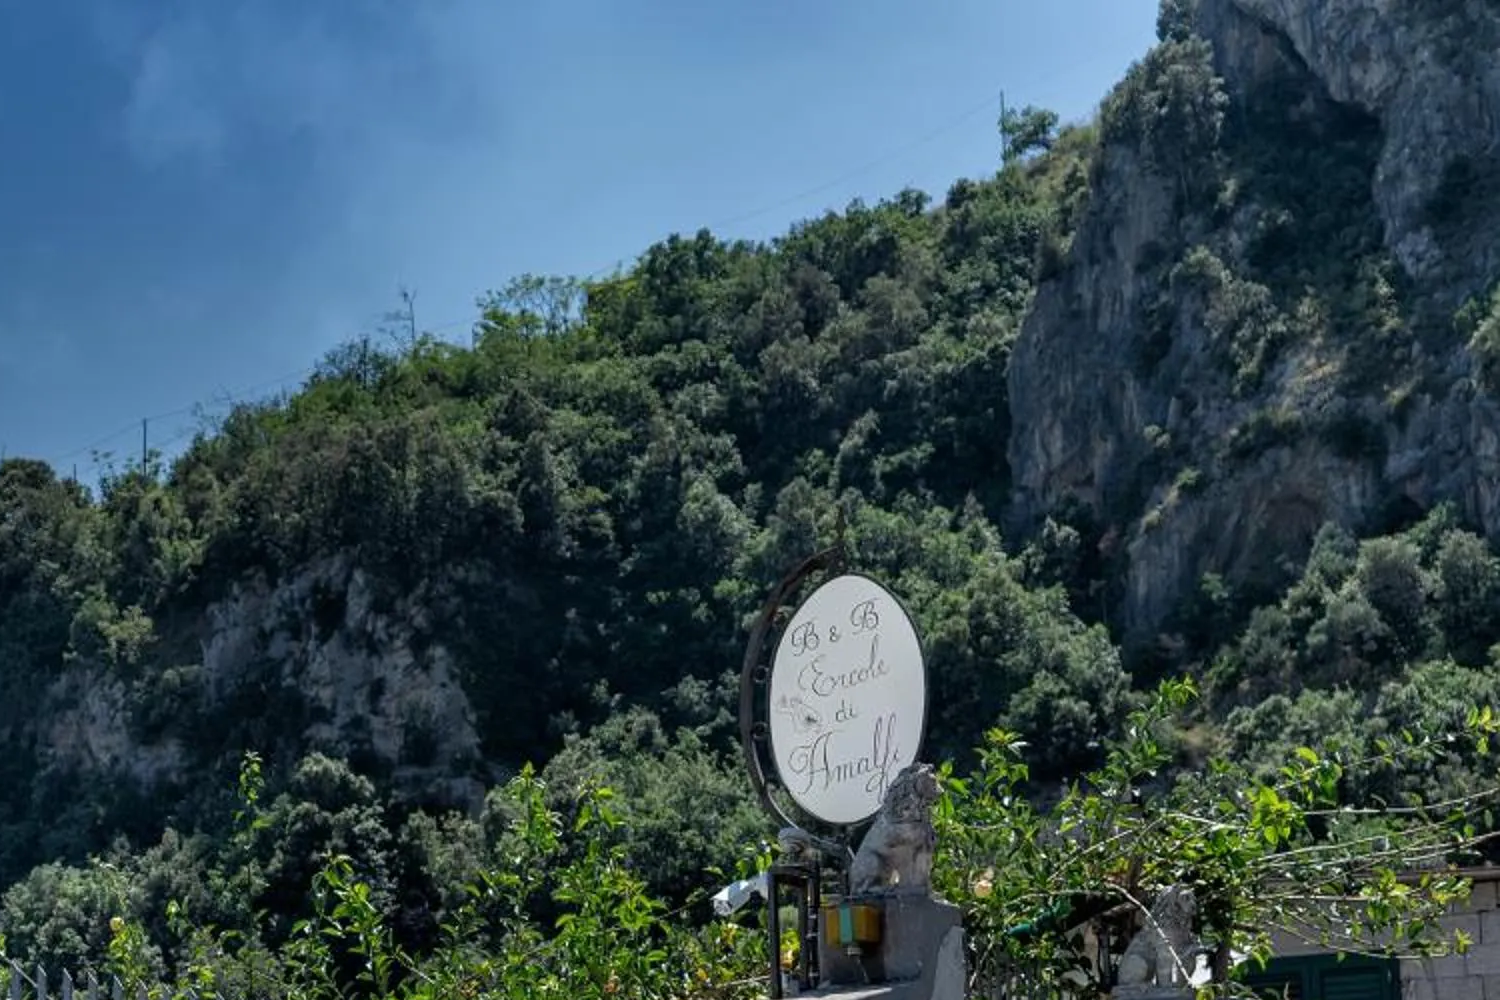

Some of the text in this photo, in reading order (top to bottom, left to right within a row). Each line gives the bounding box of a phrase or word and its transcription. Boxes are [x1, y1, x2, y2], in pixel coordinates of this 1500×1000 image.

[791, 598, 879, 657] B & B
[798, 634, 888, 696] Ercole
[835, 699, 857, 722] di
